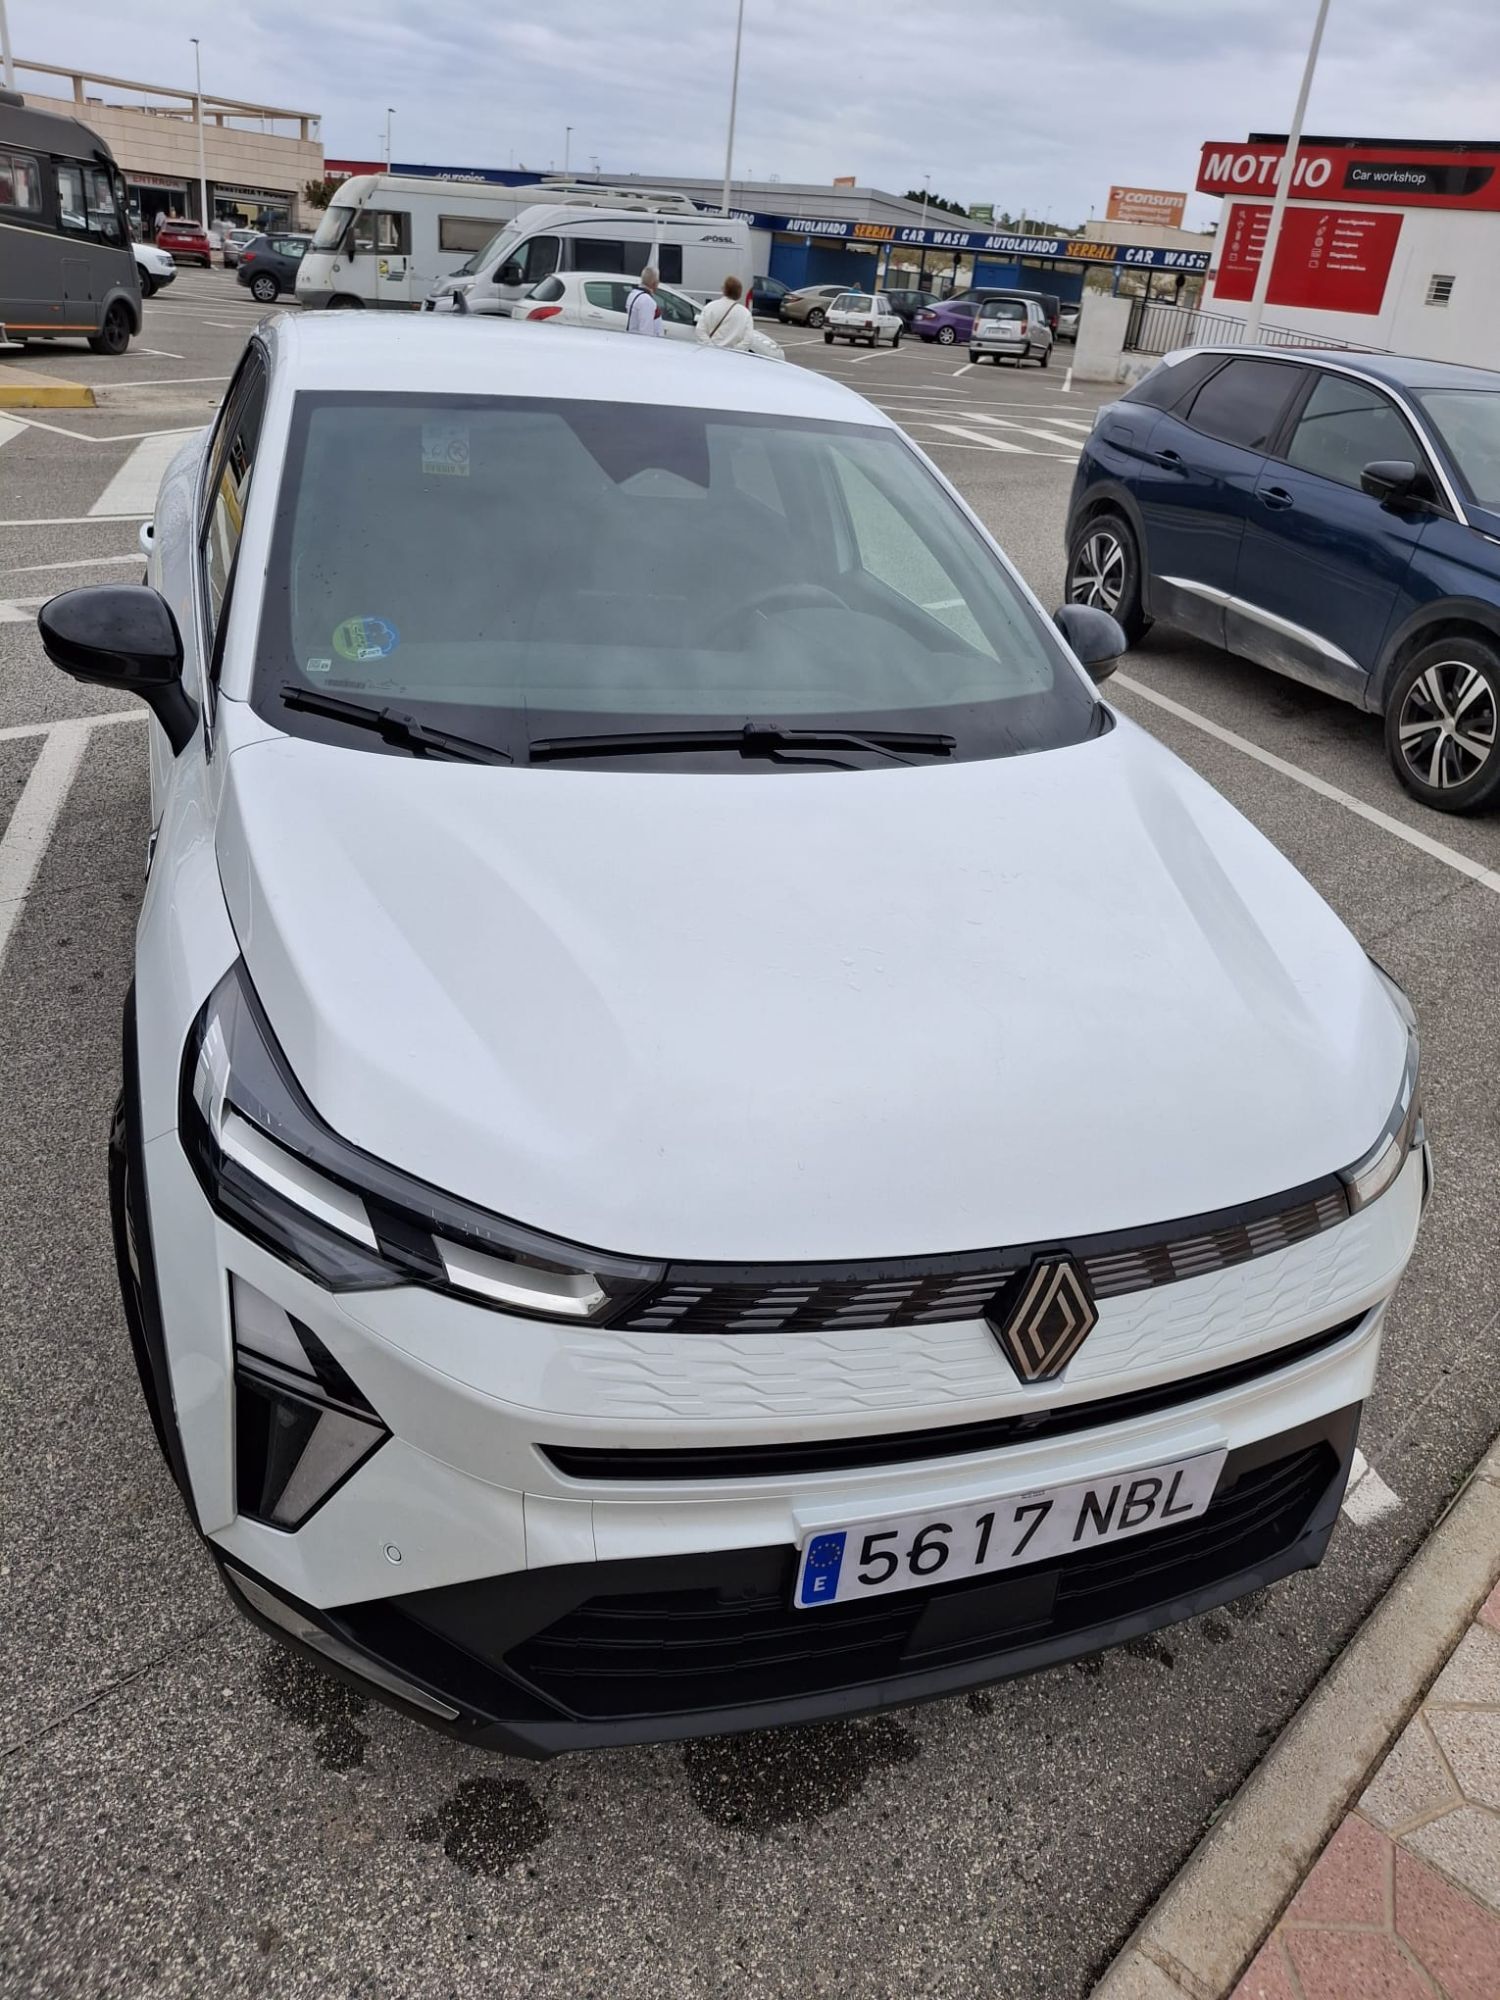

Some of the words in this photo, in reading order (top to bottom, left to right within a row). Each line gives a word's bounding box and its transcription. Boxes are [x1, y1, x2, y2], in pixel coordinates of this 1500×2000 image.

[1352, 169, 1371, 181] Car
[1373, 173, 1426, 185] workshop
[787, 219, 847, 235] AUTOLAVADO
[853, 224, 896, 240] SERRALI
[902, 230, 925, 242] CAR
[933, 232, 969, 246] WASH
[985, 236, 1058, 253] AUTOLAVADO
[1065, 242, 1117, 260] SERRALI
[1125, 248, 1153, 264] CAR
[813, 1576, 827, 1591] E
[857, 1500, 1054, 1586] 5617
[1072, 1470, 1193, 1542] NBL
